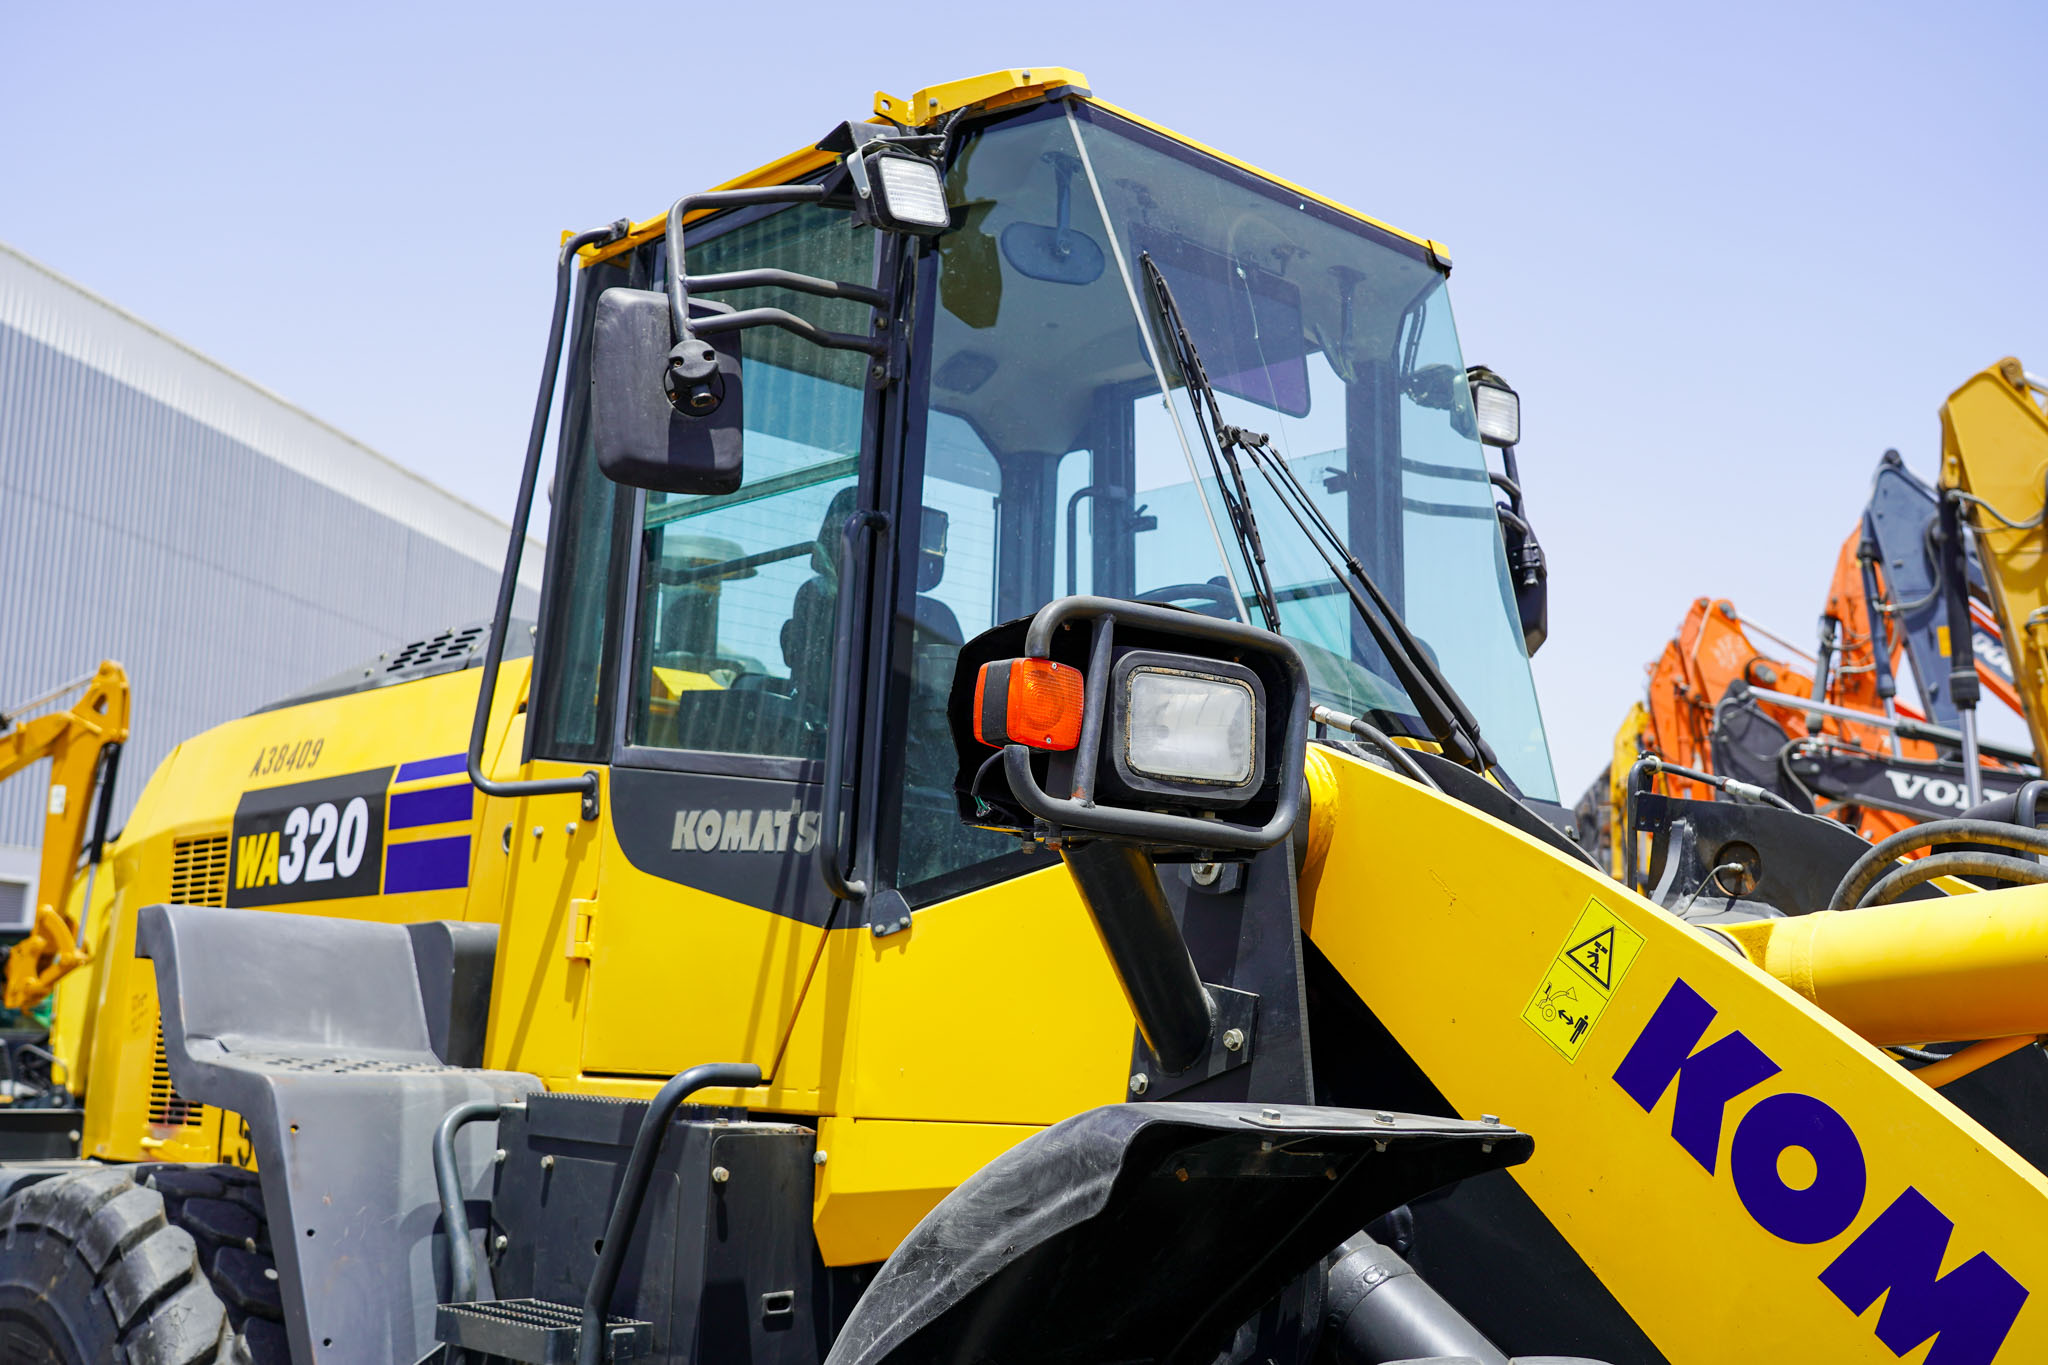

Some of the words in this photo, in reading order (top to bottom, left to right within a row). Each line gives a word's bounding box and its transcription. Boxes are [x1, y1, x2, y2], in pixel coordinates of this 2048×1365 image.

[249, 738, 325, 778] A38409
[235, 796, 369, 890] WA320
[1612, 977, 2030, 1365] KOM
